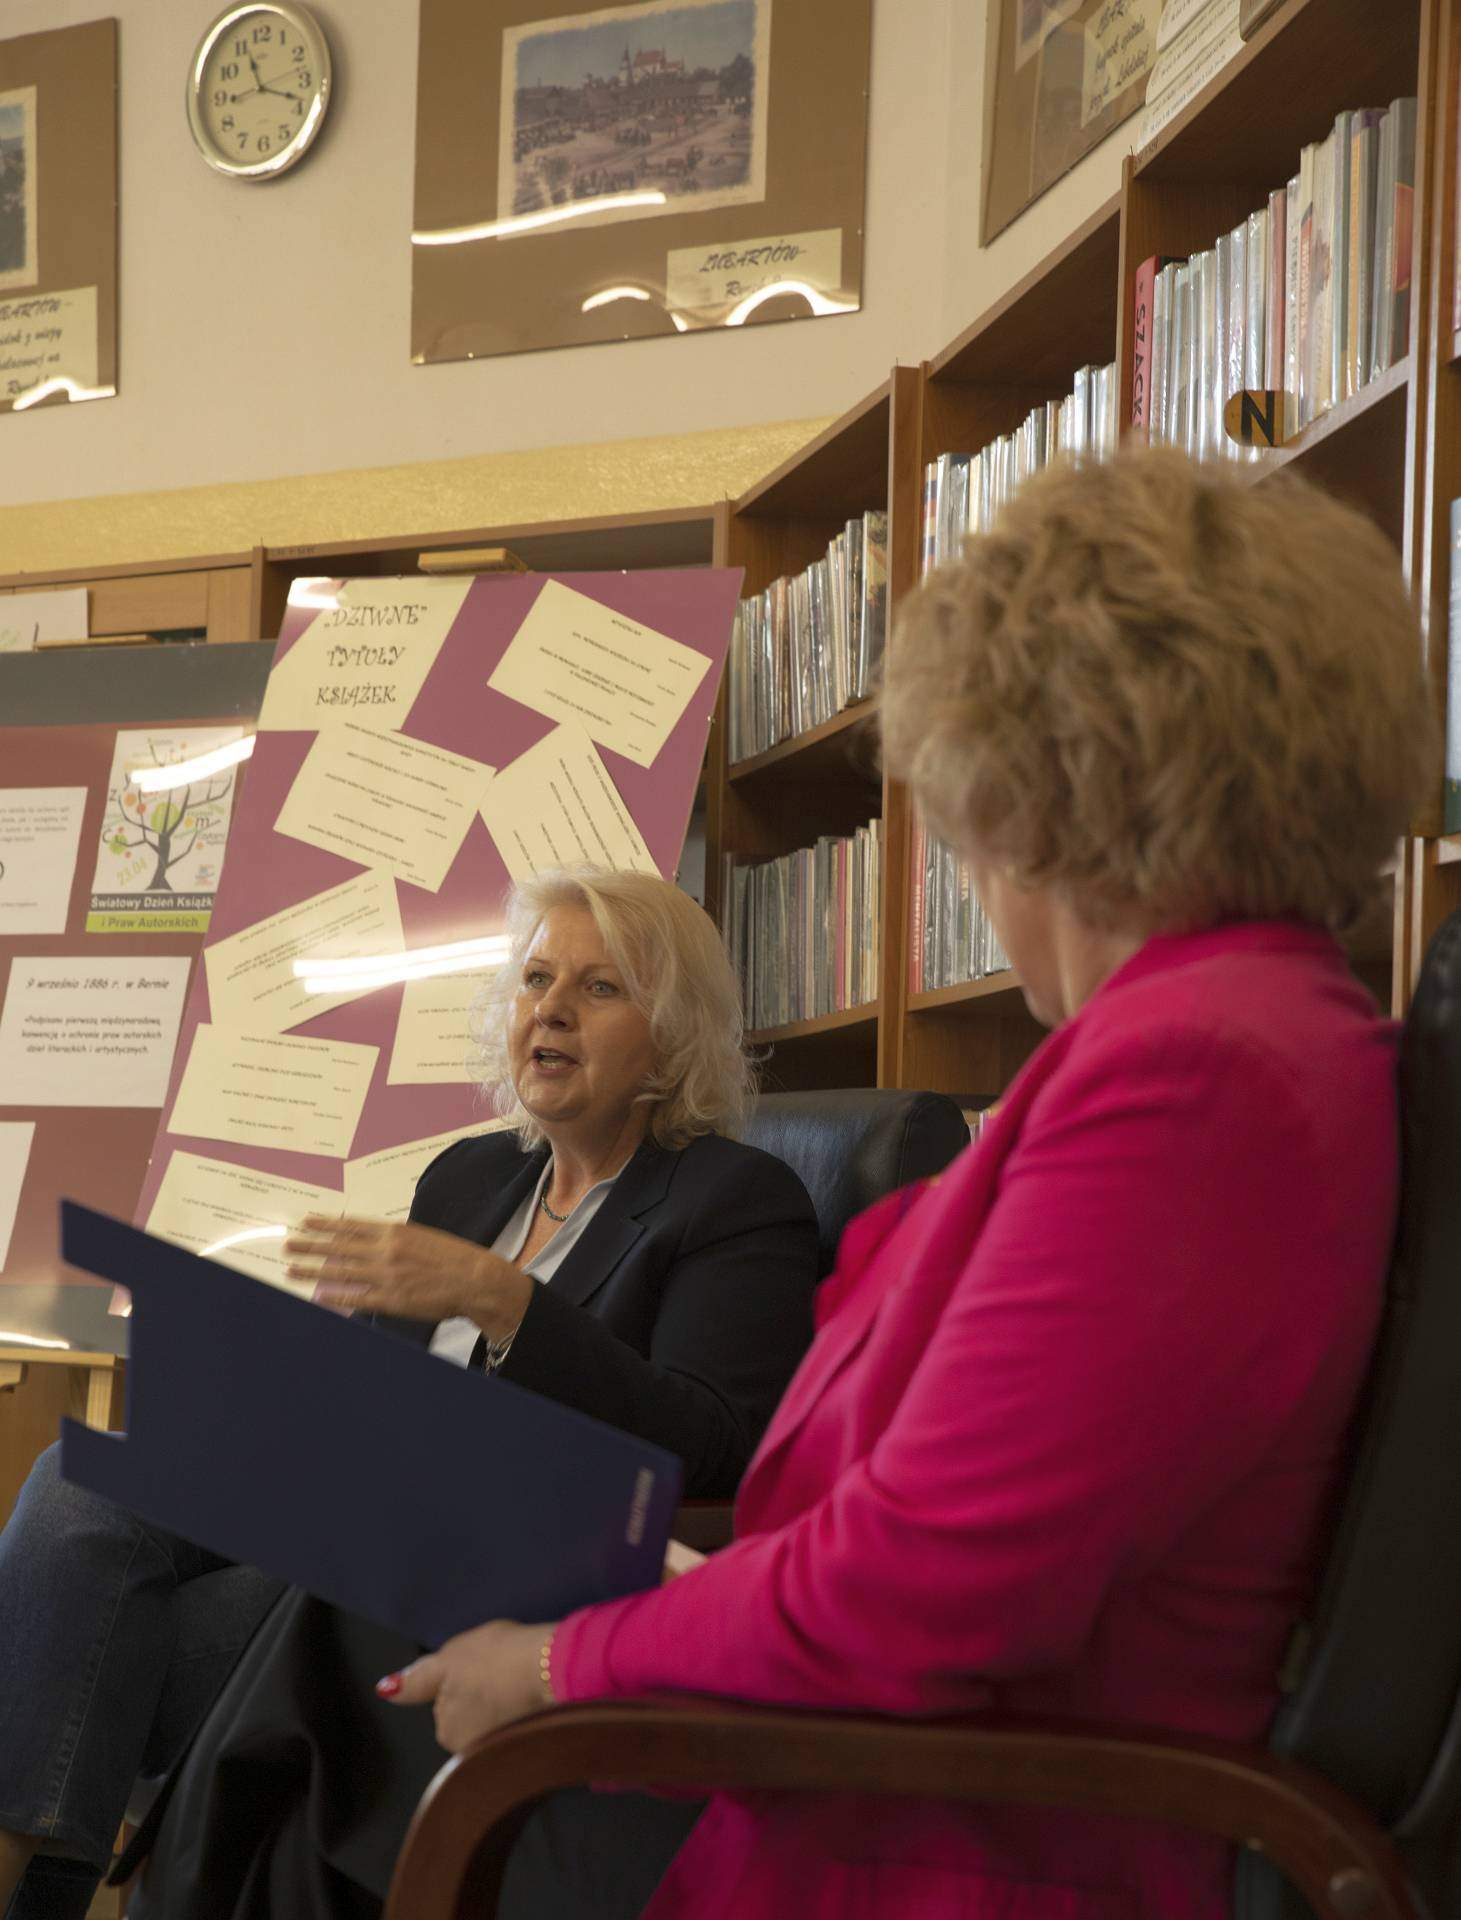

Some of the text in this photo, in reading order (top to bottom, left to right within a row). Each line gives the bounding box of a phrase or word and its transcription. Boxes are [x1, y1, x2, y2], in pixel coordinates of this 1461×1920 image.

[252, 25, 271, 44] 12
[280, 29, 286, 45] 1
[235, 39, 248, 56] 11
[292, 46, 305, 62] 2
[220, 62, 239, 81] 10
[298, 72, 311, 88] 3
[214, 91, 227, 106] 9
[222, 116, 235, 132] 8
[278, 124, 290, 140] 5
[237, 132, 248, 149] 7
[257, 135, 270, 151] 6
[1240, 390, 1276, 447] N
[327, 645, 406, 668] TYTUŁY
[315, 683, 397, 708] KSIĄŻEK
[91, 895, 140, 912] Światowy
[143, 896, 175, 909] Dzień
[107, 916, 134, 928] Praw
[138, 915, 199, 928] Autorskich
[26, 978, 34, 989] 9
[137, 977, 170, 990] Bernie
